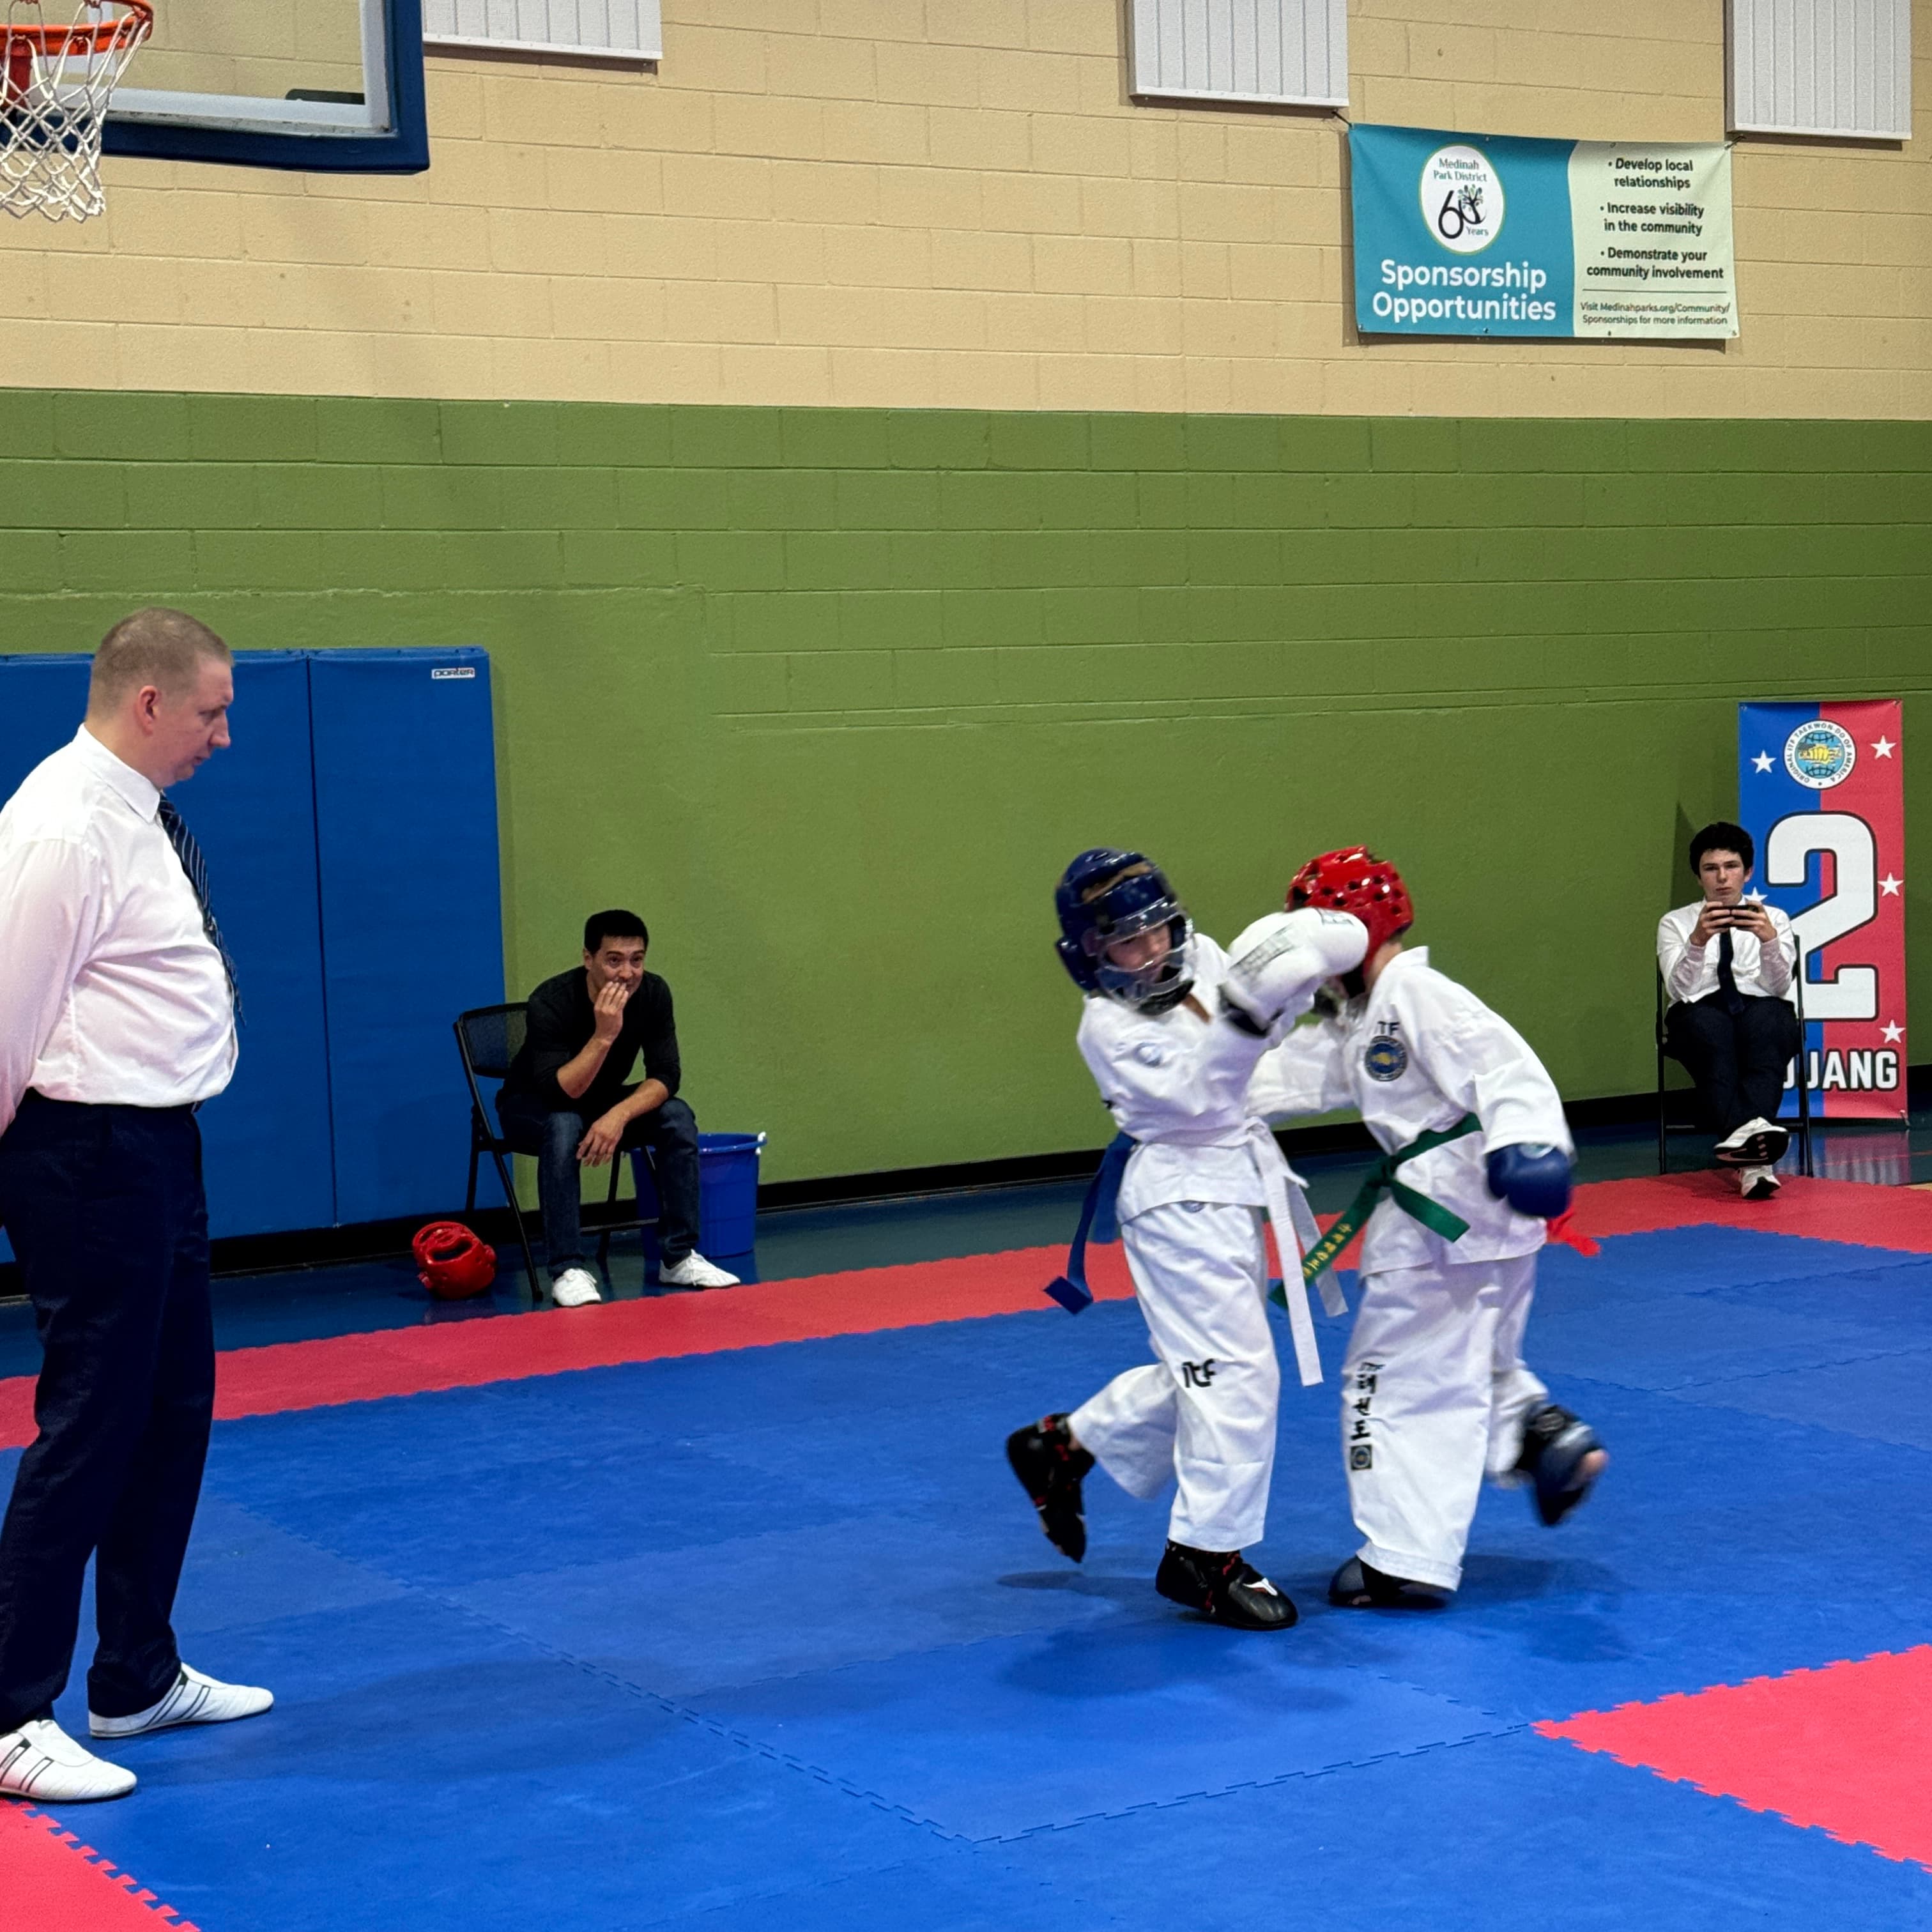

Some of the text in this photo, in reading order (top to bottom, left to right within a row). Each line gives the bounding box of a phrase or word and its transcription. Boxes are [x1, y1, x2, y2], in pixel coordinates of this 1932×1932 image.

[1439, 158, 1480, 171] Medinah
[1615, 158, 1693, 172] Develop local
[1433, 170, 1487, 182] Park District
[1614, 175, 1691, 190] relationships
[1607, 202, 1705, 219] Increase visibility
[1466, 226, 1489, 236] Years
[1604, 218, 1703, 236] in the community
[1607, 247, 1708, 263] Demonstrate your
[1381, 259, 1547, 294] Sponsorship
[1586, 264, 1724, 280] community involvement
[1372, 291, 1556, 323] Opportunities
[1580, 302, 1598, 311] Visit
[1582, 314, 1638, 325] Sponsorships
[1639, 315, 1651, 324] for
[1677, 316, 1728, 325] information
[1786, 723, 1853, 784] ORIGINAL ITF TAEKWON-DO OF AMERICA
[1766, 813, 1877, 1020] 2
